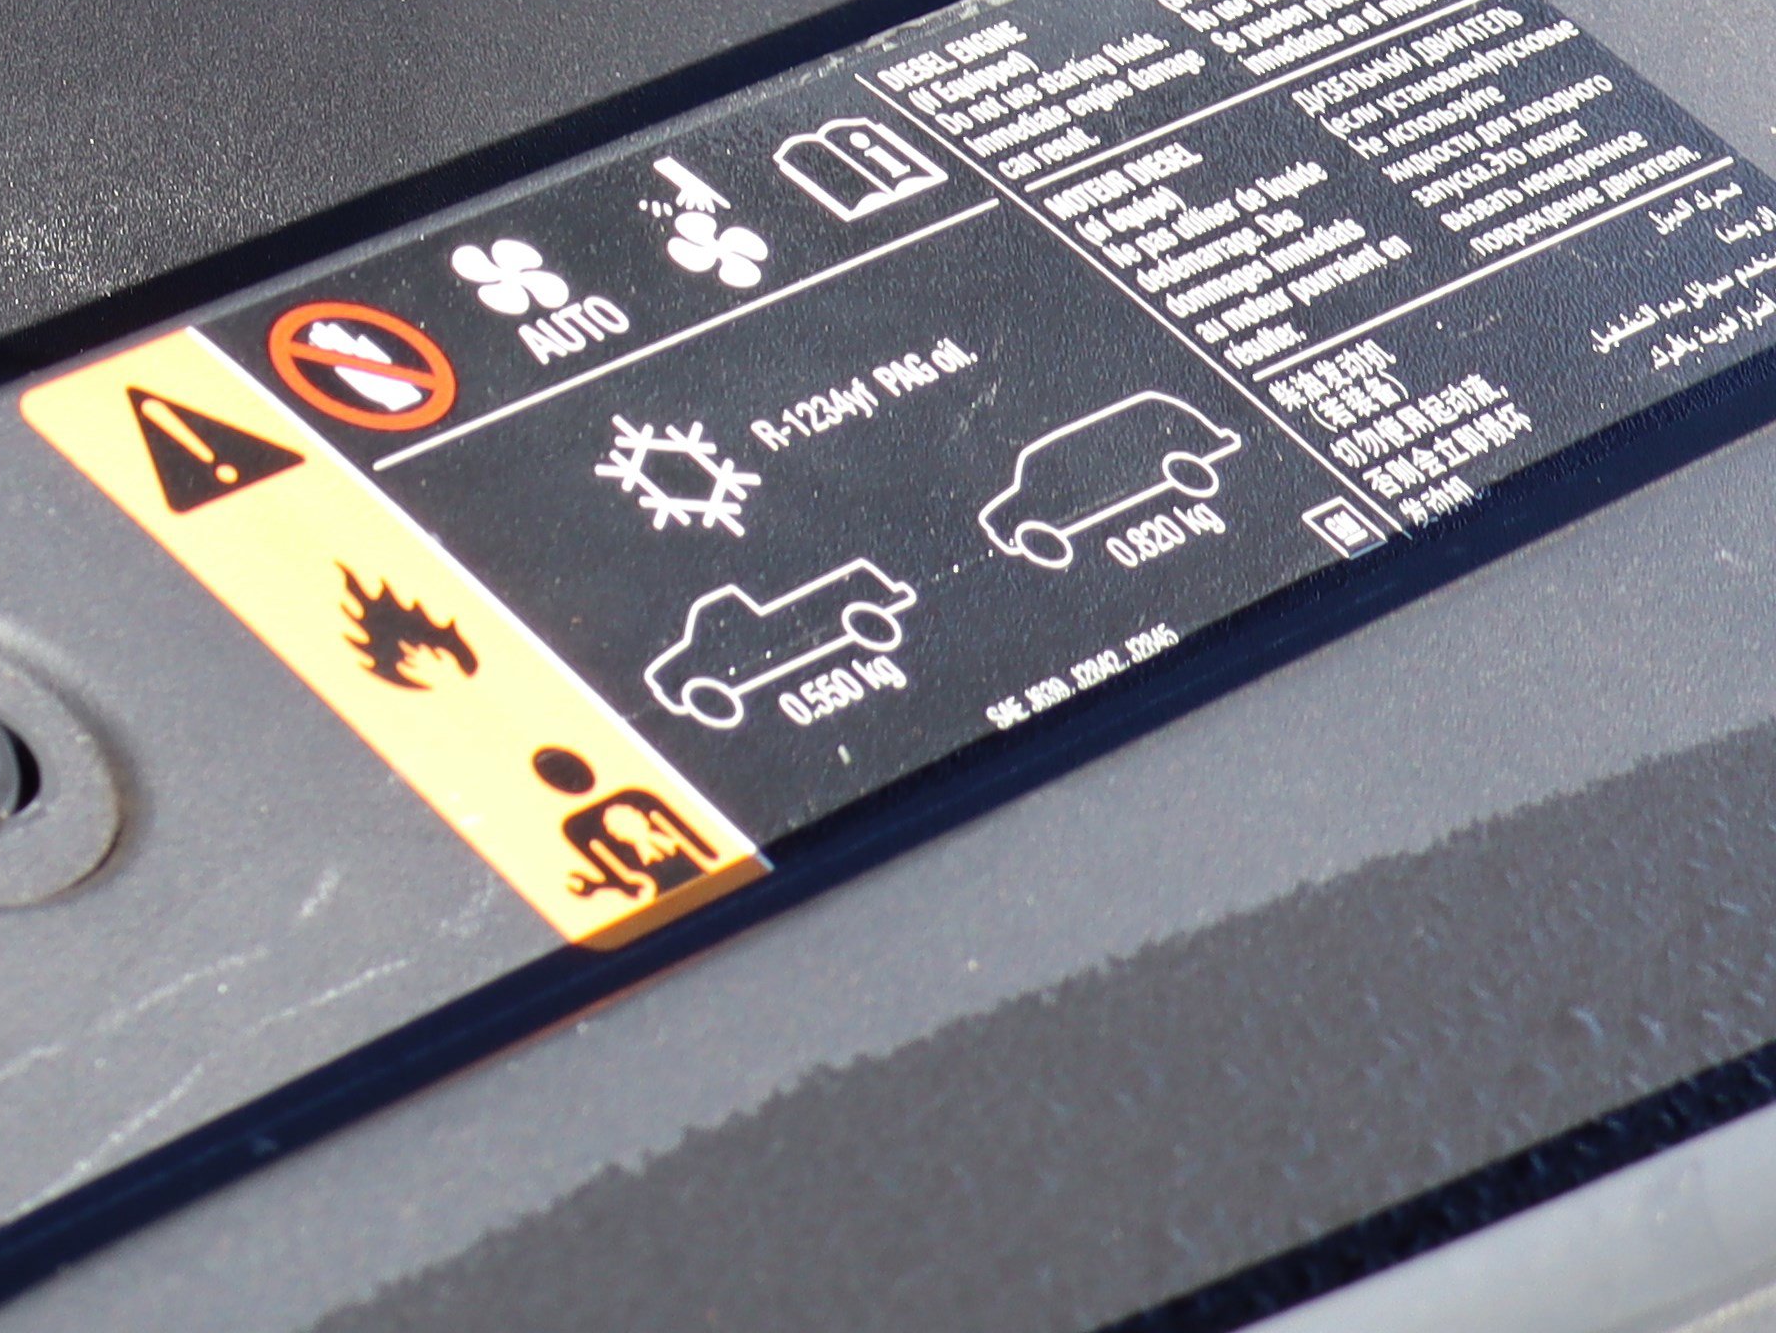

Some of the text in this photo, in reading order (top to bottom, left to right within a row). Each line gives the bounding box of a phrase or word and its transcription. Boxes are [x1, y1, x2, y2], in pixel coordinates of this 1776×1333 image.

[875, 19, 1027, 92] DIESEL ENGINE
[1179, 8, 1220, 33] No
[1209, 30, 1247, 53] Se
[1238, 3, 1313, 47] pueden
[1236, 23, 1345, 76] inmediatos
[1336, 13, 1370, 36] en
[1360, 0, 1389, 26] el
[907, 48, 1040, 116] (If Equipped)
[933, 31, 1170, 136] Do not use starting fluids.
[1290, 5, 1524, 119] ДИЗЕЛЬНЫЙ ДВИГАТЕЛЬ
[962, 48, 1206, 158] Immediate engine damage
[1318, 101, 1384, 141] (если
[1346, 84, 1506, 160] Не используйте
[1380, 73, 1613, 184] жидкости для холодного
[1520, 118, 1588, 159] может
[997, 125, 1101, 180] can result.
[1042, 141, 1204, 221] MOTEUR DIESEL
[1439, 129, 1648, 232] вызвать немедленное
[1073, 183, 1188, 247] (si équipé)
[1100, 160, 1328, 269] Ne pas utiliser de liquide
[1468, 144, 1702, 257] повреждение двигателя.
[1135, 207, 1304, 293] dedémarrage. Des
[1164, 217, 1366, 319] dommages immédiats
[1194, 234, 1412, 344] au moteur pourraient en
[517, 295, 630, 365] AUTO
[1222, 320, 1307, 370] résulter.
[750, 337, 978, 451] R-1234yf PAG oil.
[1267, 337, 1397, 412] 柴油发动机
[1361, 401, 1533, 500] 否则会立即损坏
[1106, 502, 1226, 568] 0.820 kg
[1324, 510, 1368, 546] GM
[778, 655, 907, 726] 0.550 kg
[986, 696, 1030, 730] SAE
